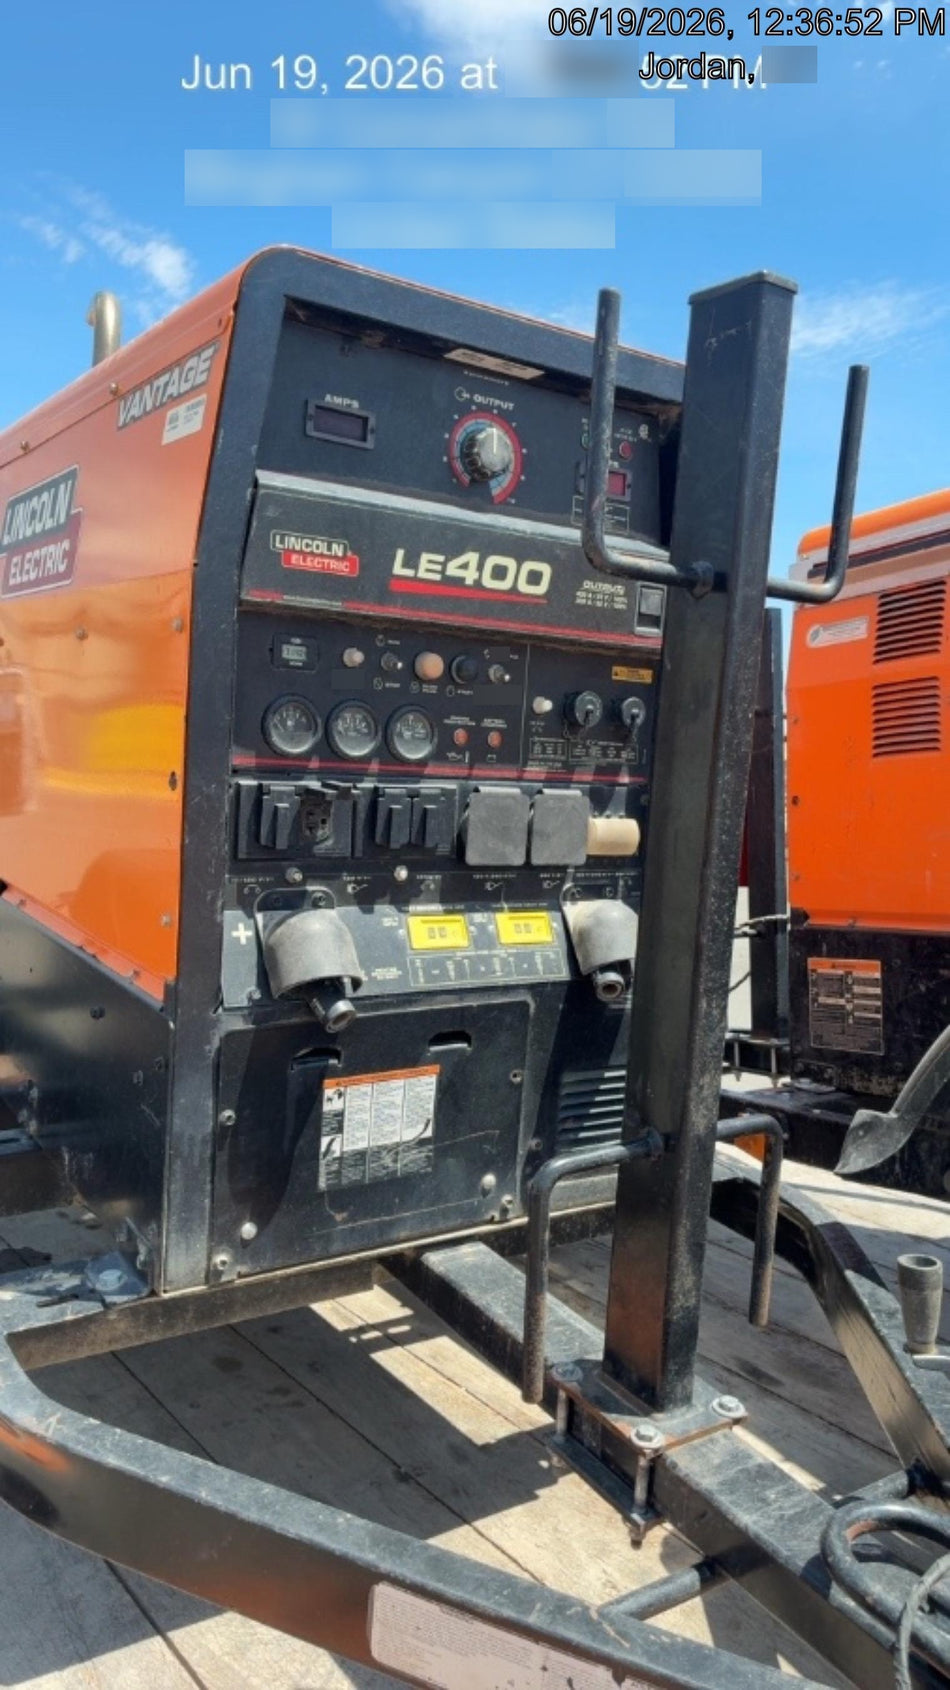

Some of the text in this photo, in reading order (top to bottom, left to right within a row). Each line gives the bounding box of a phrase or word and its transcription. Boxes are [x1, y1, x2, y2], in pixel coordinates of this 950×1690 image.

[117, 346, 216, 428] VANTAGE
[324, 394, 360, 409] AMPS
[473, 394, 515, 411] OUTPUT
[3, 480, 73, 546] LINCOLN
[8, 538, 71, 586] ELECTRIC
[275, 534, 345, 557] LINCOLN
[290, 553, 351, 572] ELECTRIC
[392, 548, 552, 596] LE400
